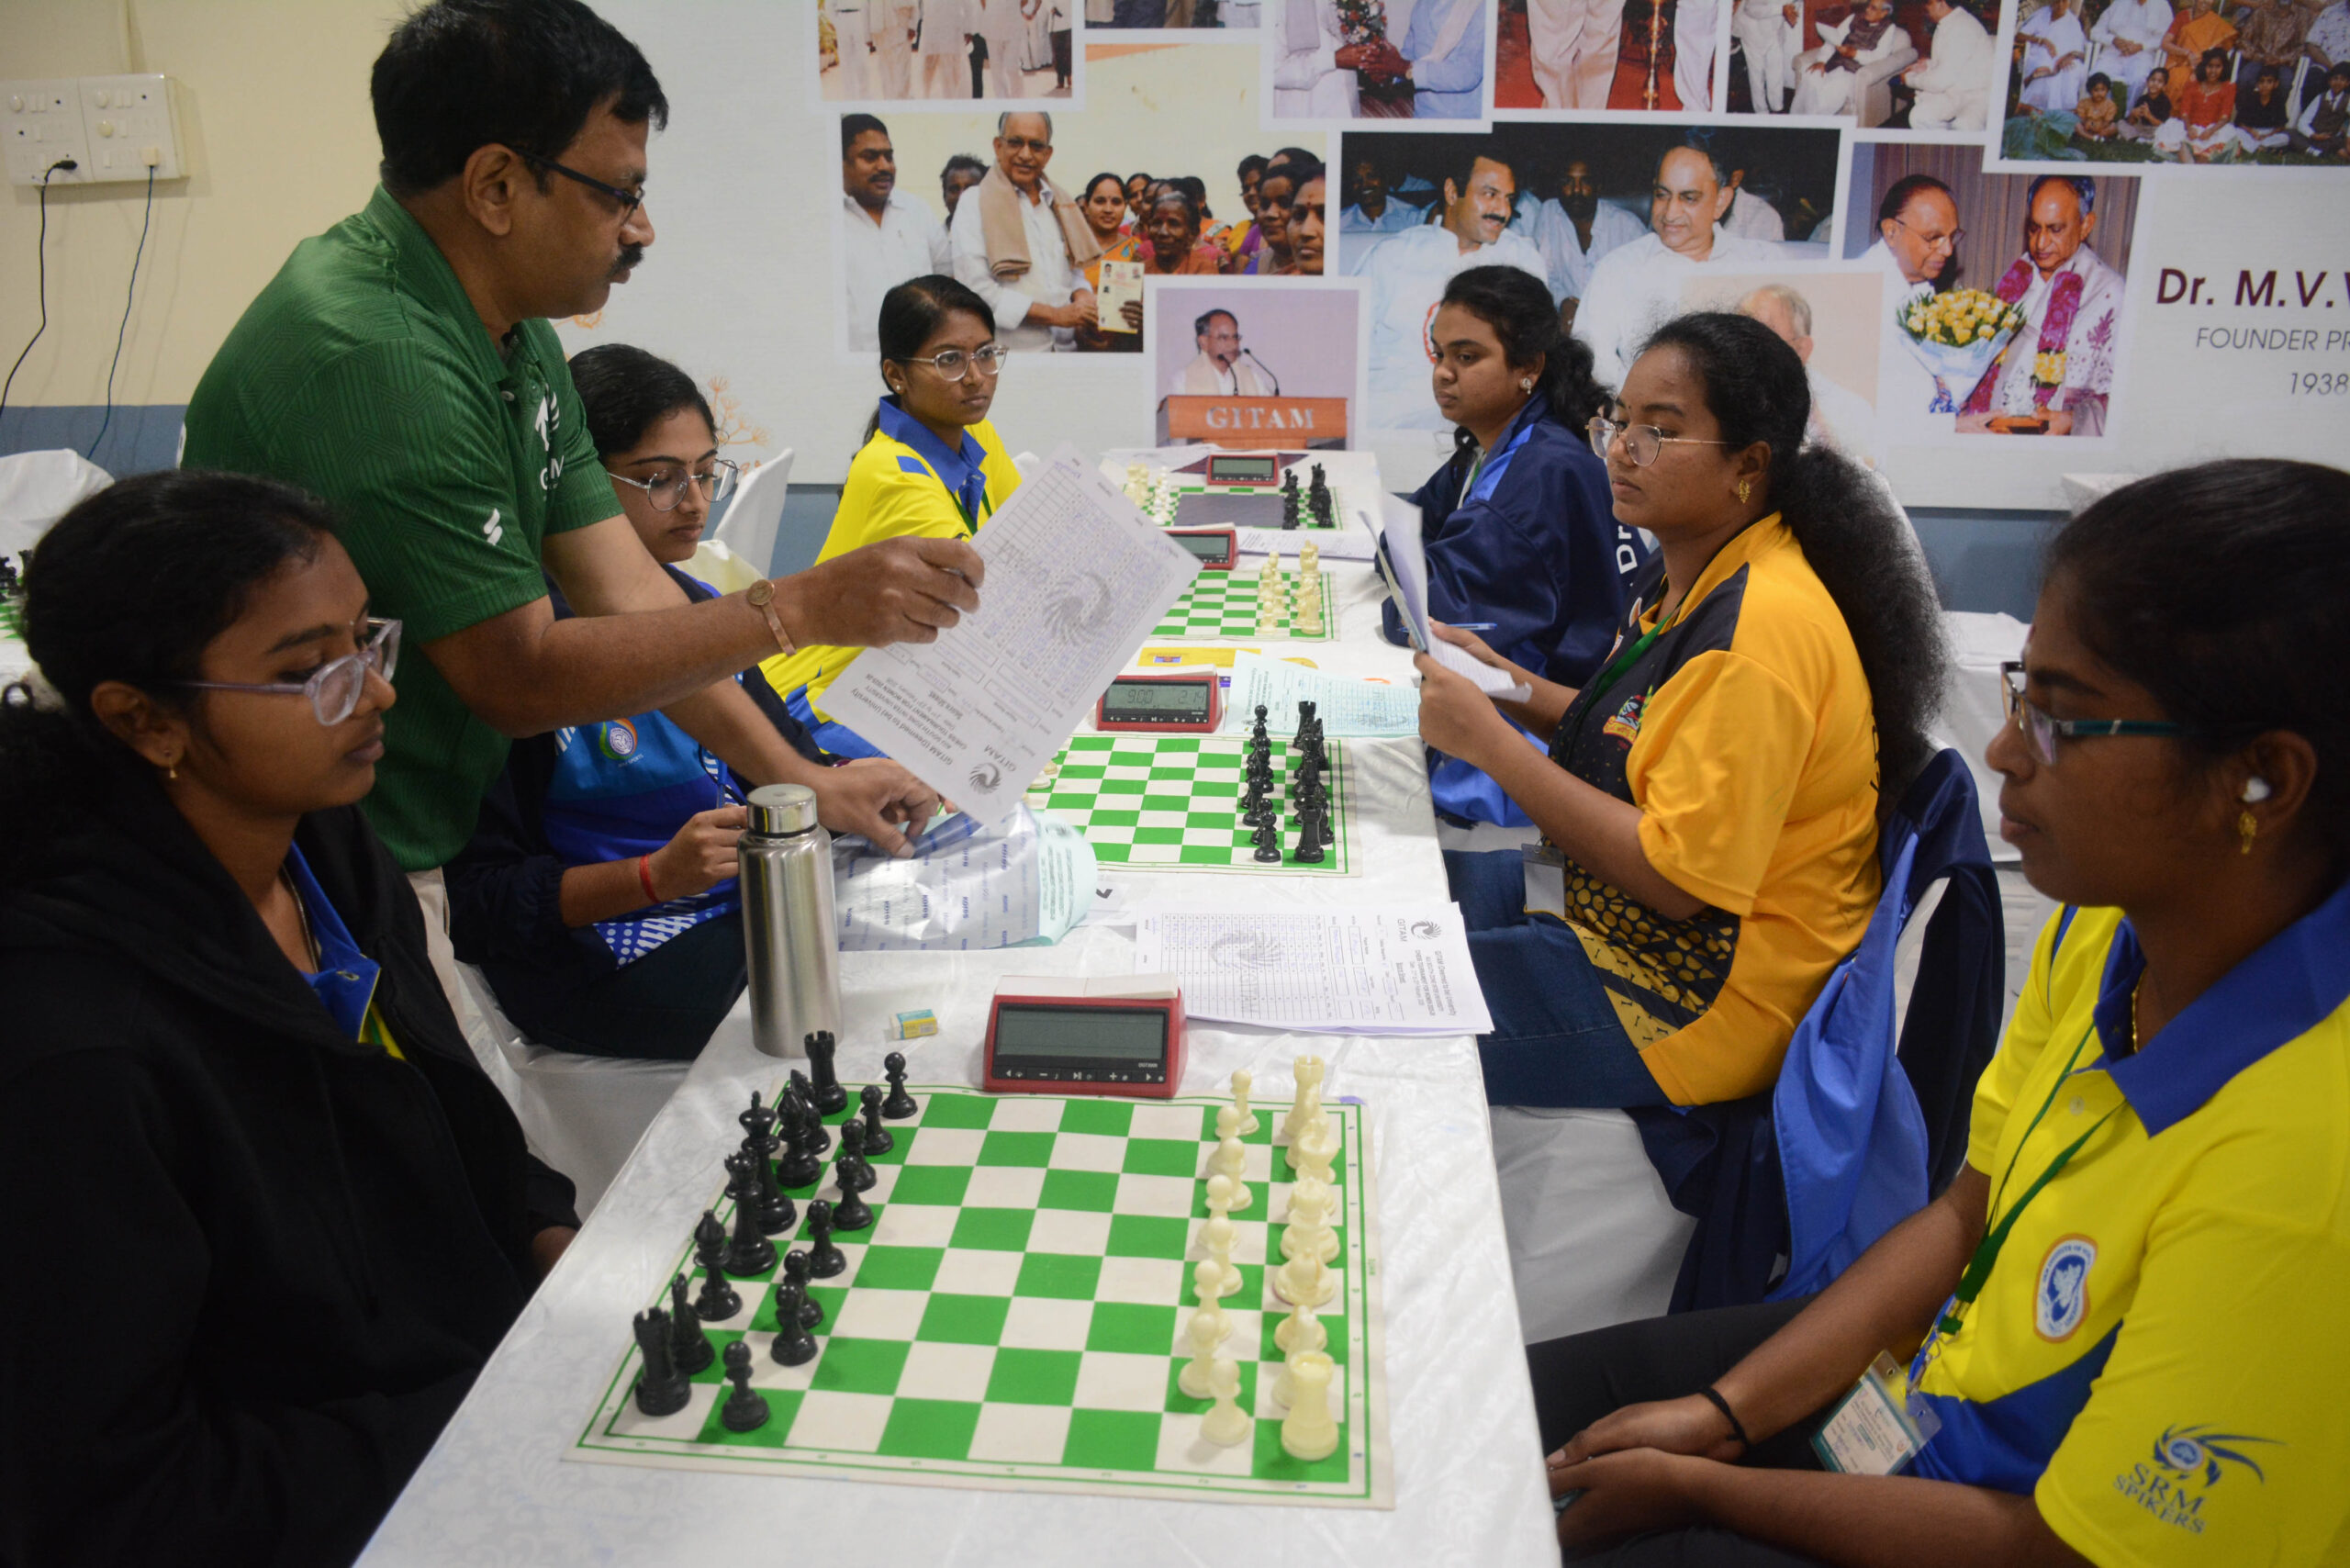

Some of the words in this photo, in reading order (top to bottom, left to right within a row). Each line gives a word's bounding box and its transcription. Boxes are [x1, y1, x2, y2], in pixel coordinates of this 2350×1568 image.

[2156, 268, 2214, 306] Dr.
[2234, 270, 2350, 308] M.V.
[2197, 328, 2319, 351] FOUNDER
[2291, 373, 2349, 396] 1938
[1205, 407, 1315, 430] GITAM
[1394, 917, 1409, 943] GITAM
[2130, 1463, 2205, 1515] SRM
[2113, 1474, 2206, 1534] SPIKERS
